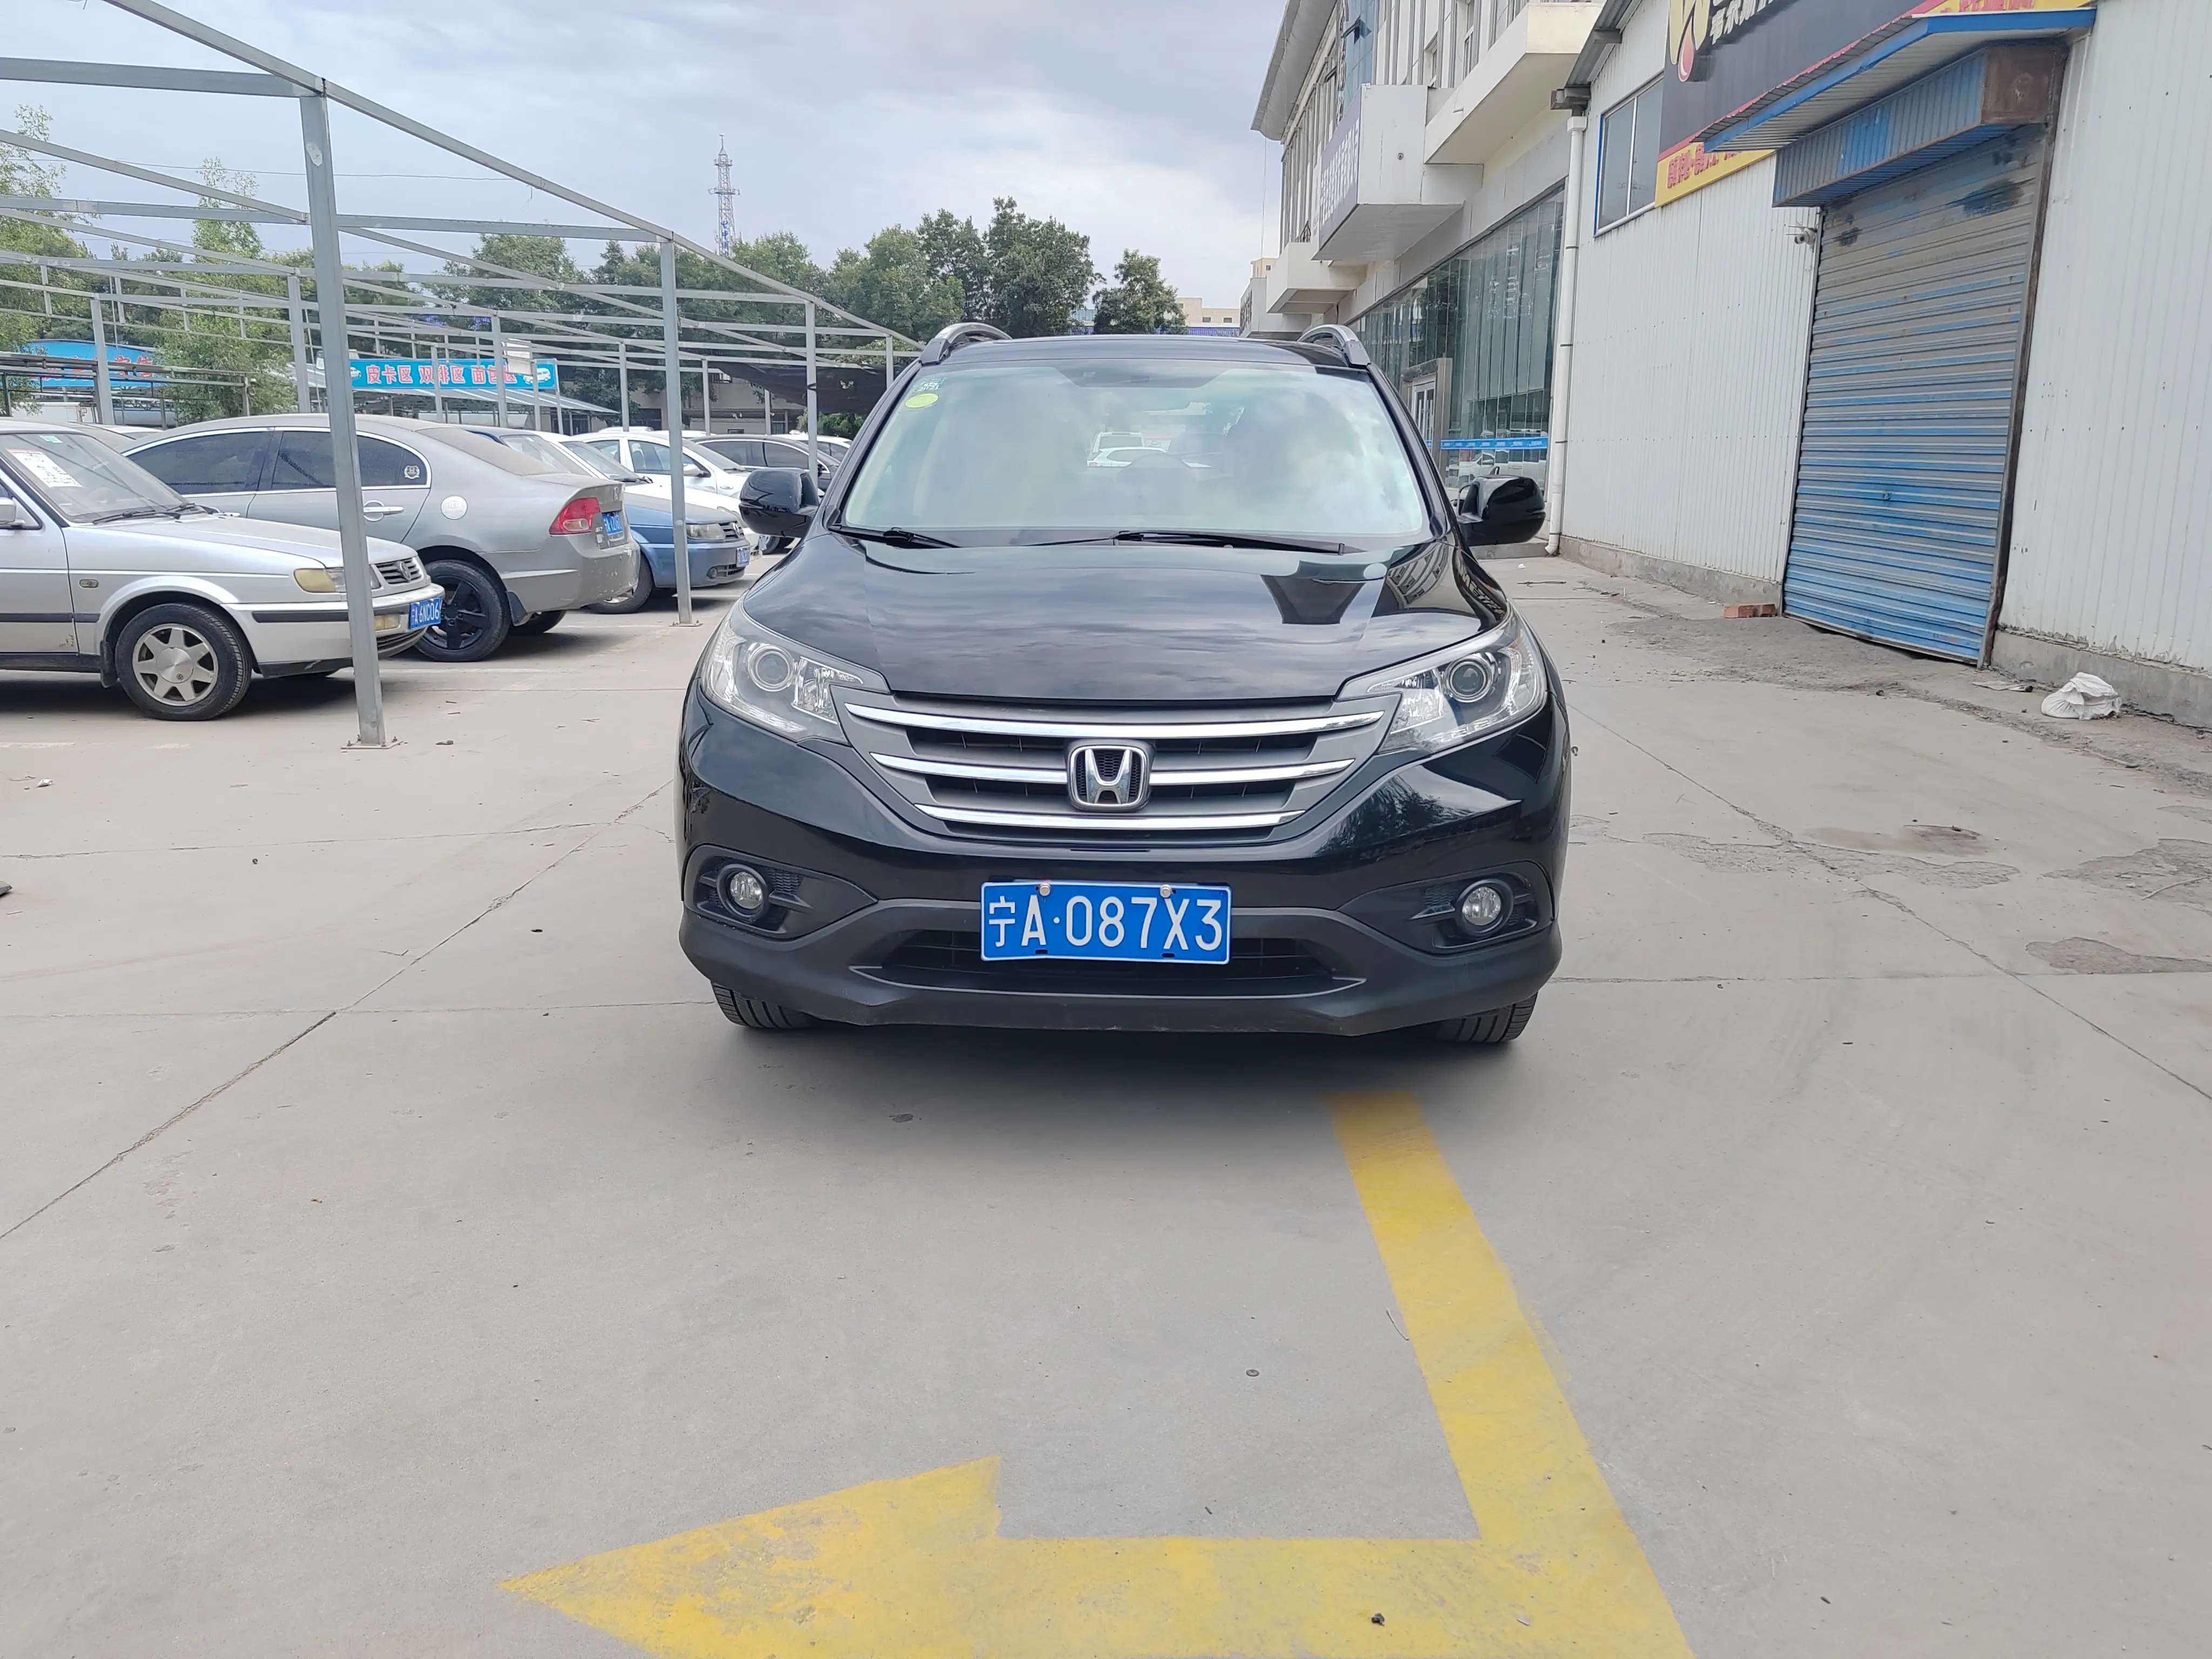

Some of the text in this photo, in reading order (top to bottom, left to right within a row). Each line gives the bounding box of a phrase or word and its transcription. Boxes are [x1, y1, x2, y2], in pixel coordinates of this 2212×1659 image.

[366, 365, 413, 384] 皮卡区
[989, 894, 1222, 950] 宁A·087X3
